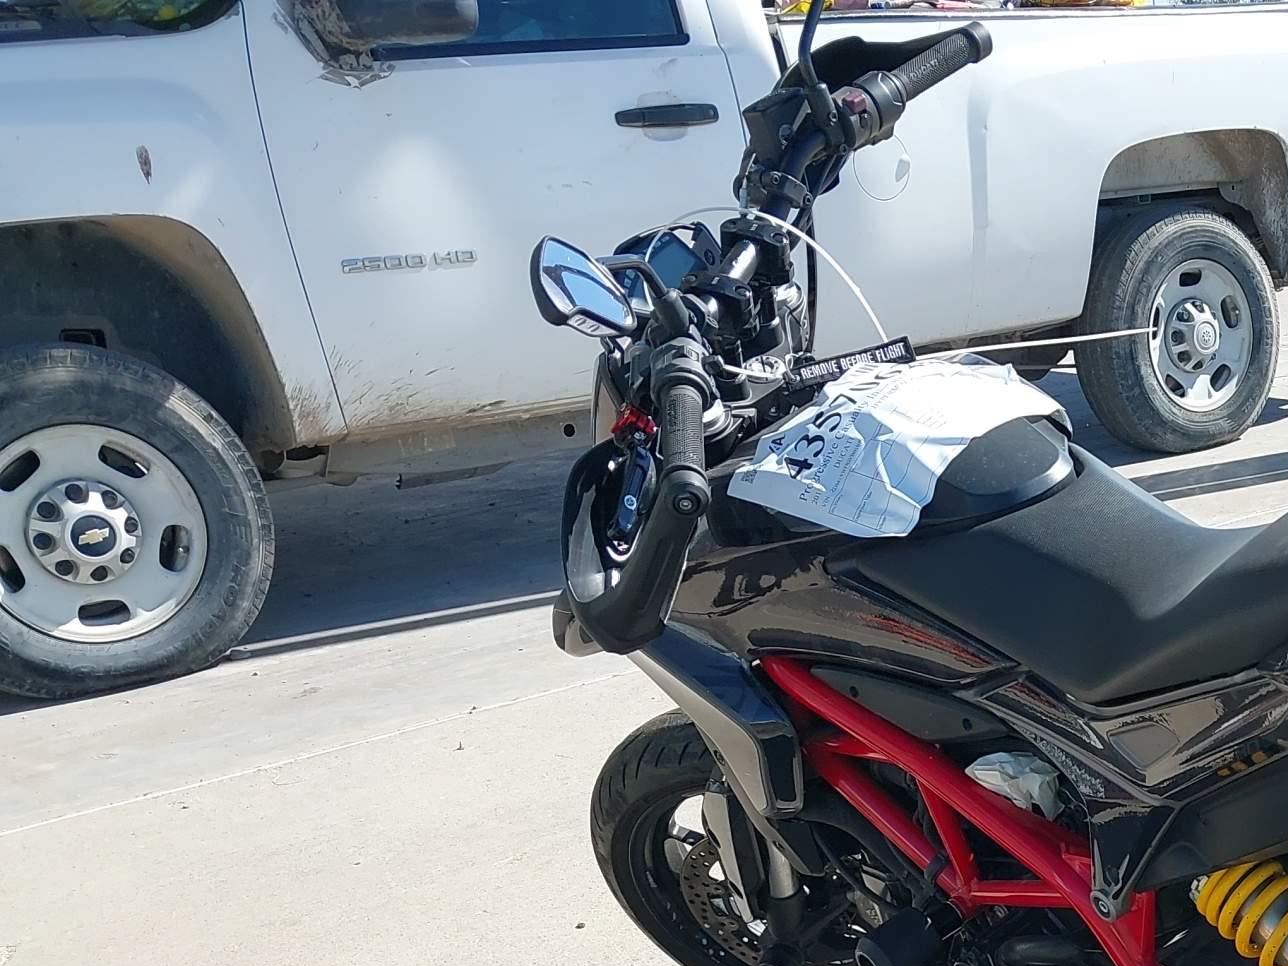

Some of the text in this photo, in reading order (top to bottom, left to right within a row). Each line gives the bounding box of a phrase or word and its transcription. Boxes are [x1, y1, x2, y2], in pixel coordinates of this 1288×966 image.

[340, 247, 478, 274] 2500 HD
[800, 342, 906, 380] REMOVE BEFORE FLIGHT
[799, 440, 840, 502] Progressive
